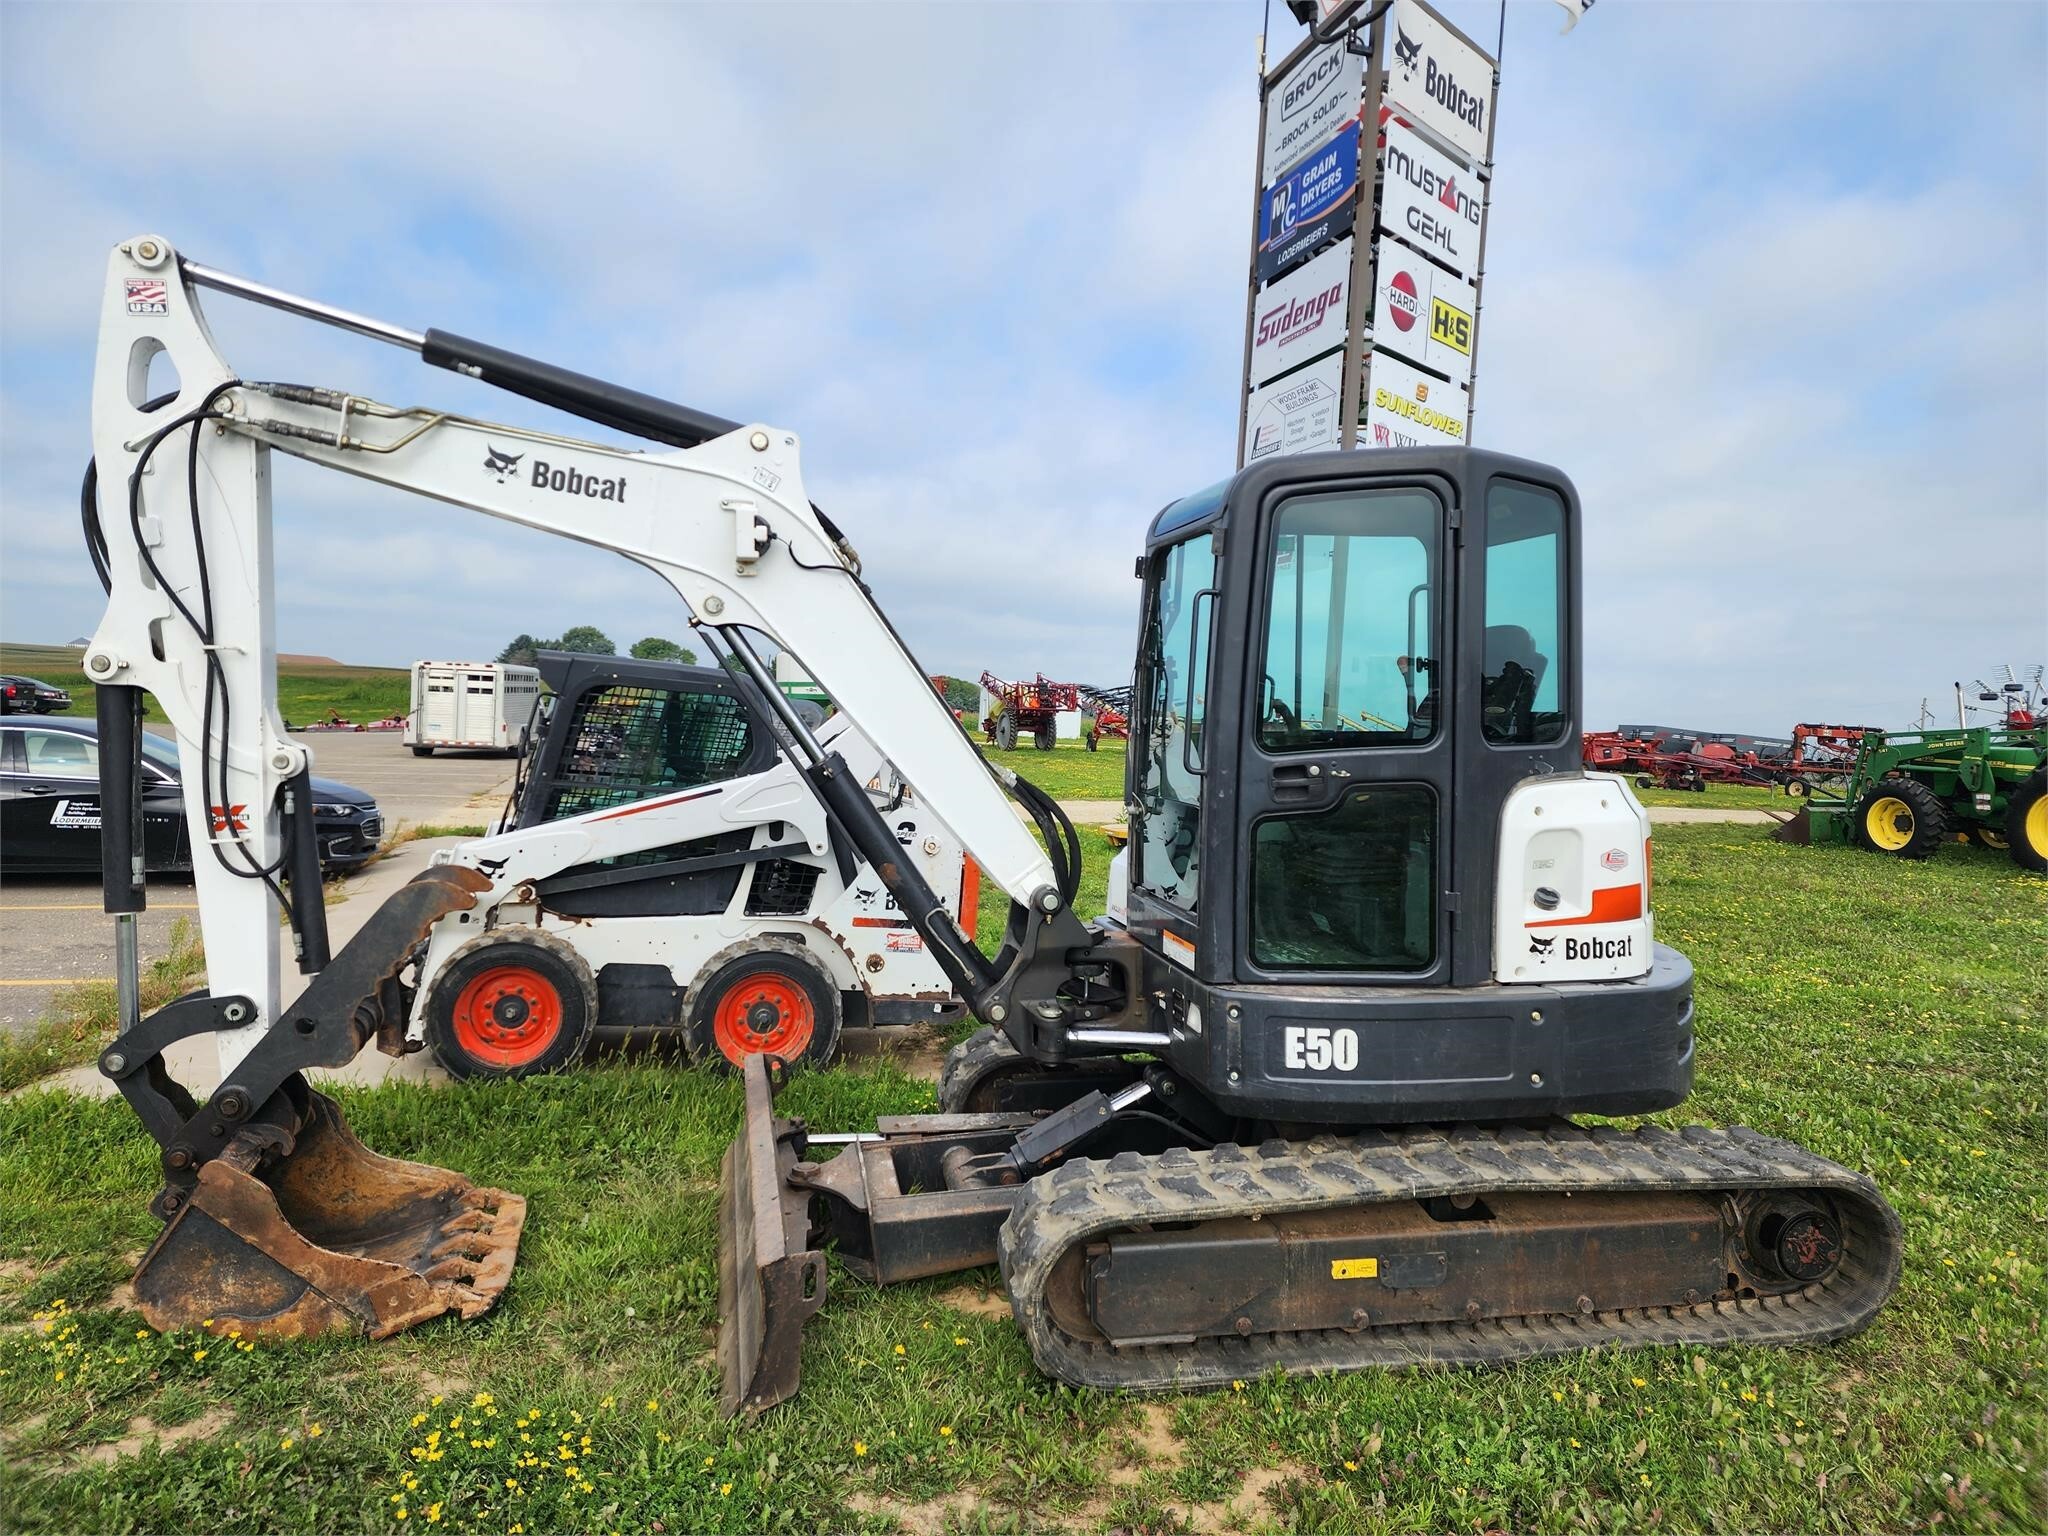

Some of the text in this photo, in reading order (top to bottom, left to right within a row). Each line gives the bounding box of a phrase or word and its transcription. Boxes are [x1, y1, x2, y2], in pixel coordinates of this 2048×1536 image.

[1284, 48, 1341, 111] BROCK
[1425, 56, 1484, 133] Bobcat
[1282, 95, 1338, 150] BROCK SOLID
[1301, 167, 1342, 207] DRYERS
[1302, 151, 1337, 187] GRAIN
[1388, 145, 1480, 225] MUSTANG
[1278, 222, 1329, 265] LODERMEIER'S
[1407, 205, 1457, 256] GEHL
[129, 303, 165, 312] USA
[1256, 282, 1343, 347] Sudenga
[1389, 288, 1418, 315] HARDI
[1434, 305, 1468, 348] H&S
[1278, 382, 1320, 405] WOOD FRAME
[1286, 391, 1319, 411] BUILDINGS
[1375, 388, 1464, 439] SUNFLOWER
[531, 460, 627, 503] Bobcat
[1566, 935, 1632, 960] Bobcat
[1286, 1026, 1359, 1071] E50
